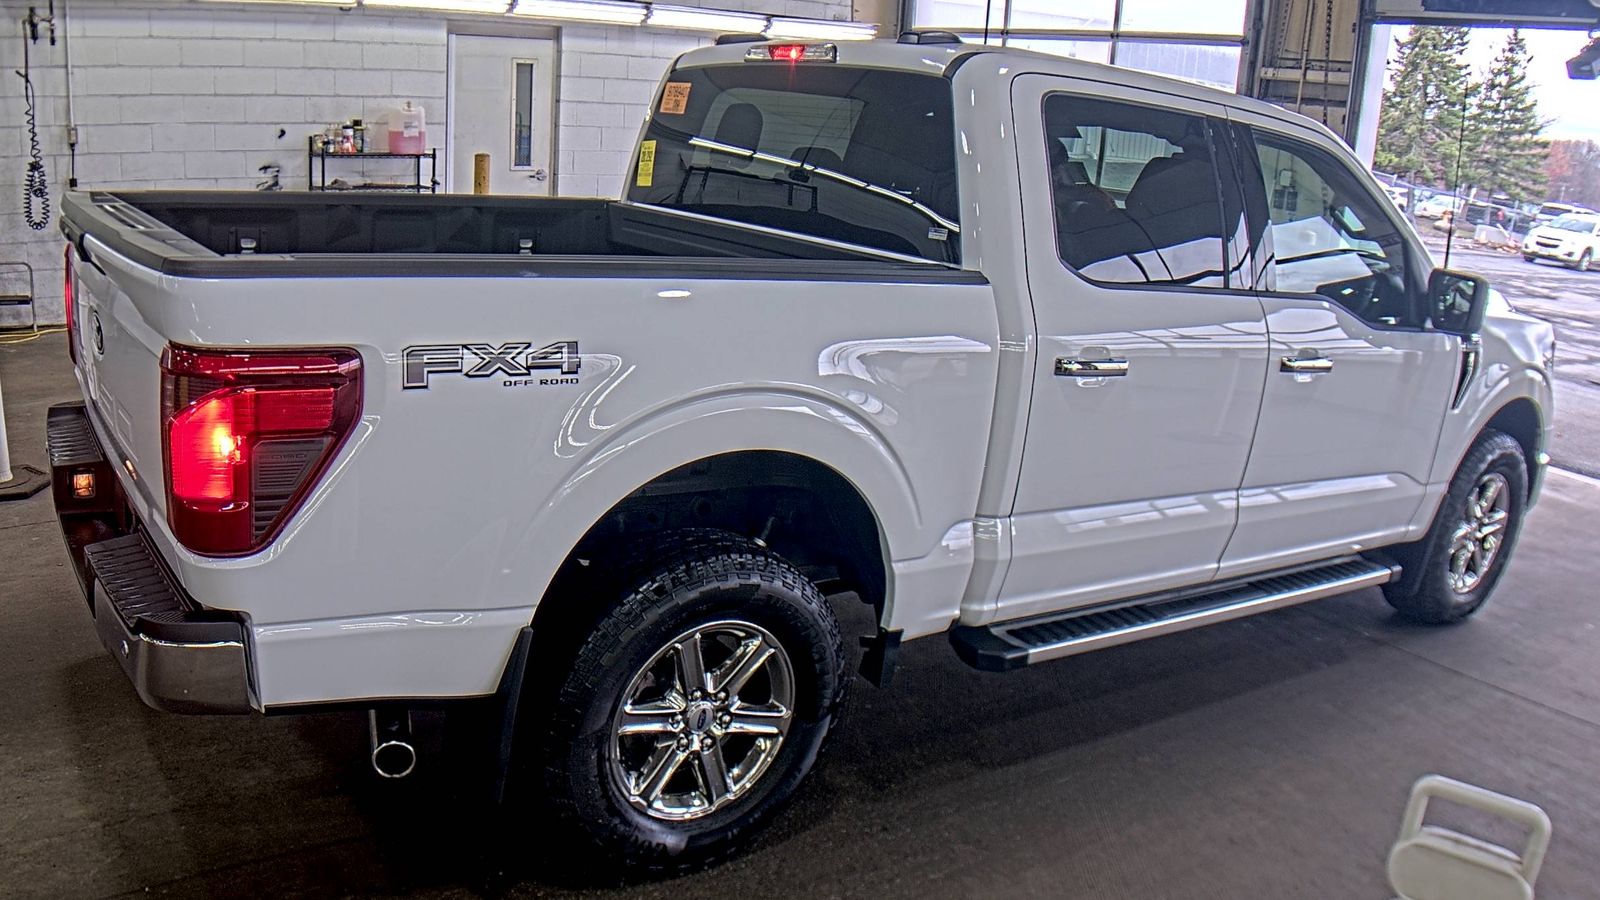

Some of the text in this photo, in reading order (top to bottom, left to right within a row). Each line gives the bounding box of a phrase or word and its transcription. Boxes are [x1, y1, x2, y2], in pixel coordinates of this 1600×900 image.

[402, 341, 581, 389] FX4
[503, 378, 579, 387] OFF ROAD
